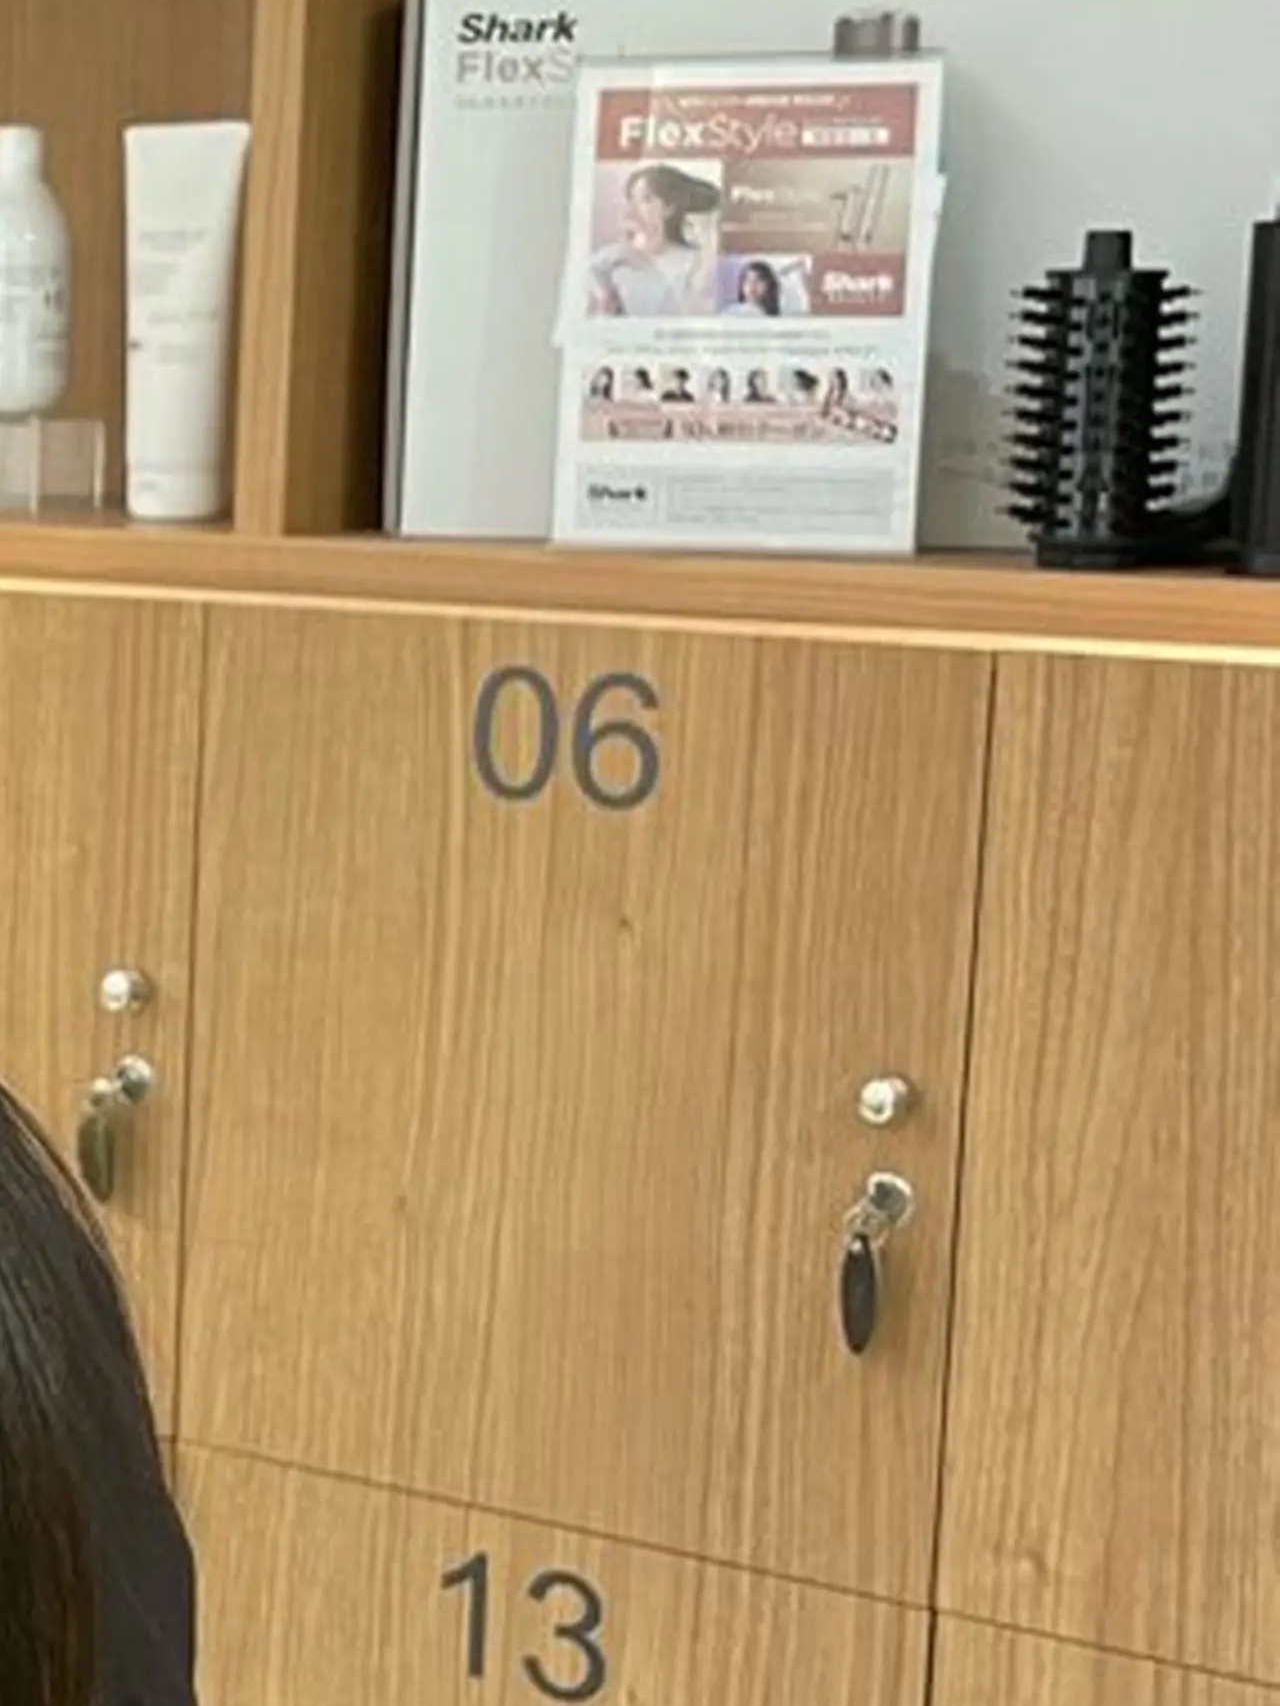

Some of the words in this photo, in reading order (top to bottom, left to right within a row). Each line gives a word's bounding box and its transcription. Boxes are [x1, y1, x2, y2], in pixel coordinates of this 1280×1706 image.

[457, 11, 578, 43] Shark
[456, 47, 574, 84] FlexS
[619, 113, 797, 153] FlexStyle
[473, 666, 660, 810] 06
[440, 1552, 607, 1703] 13
